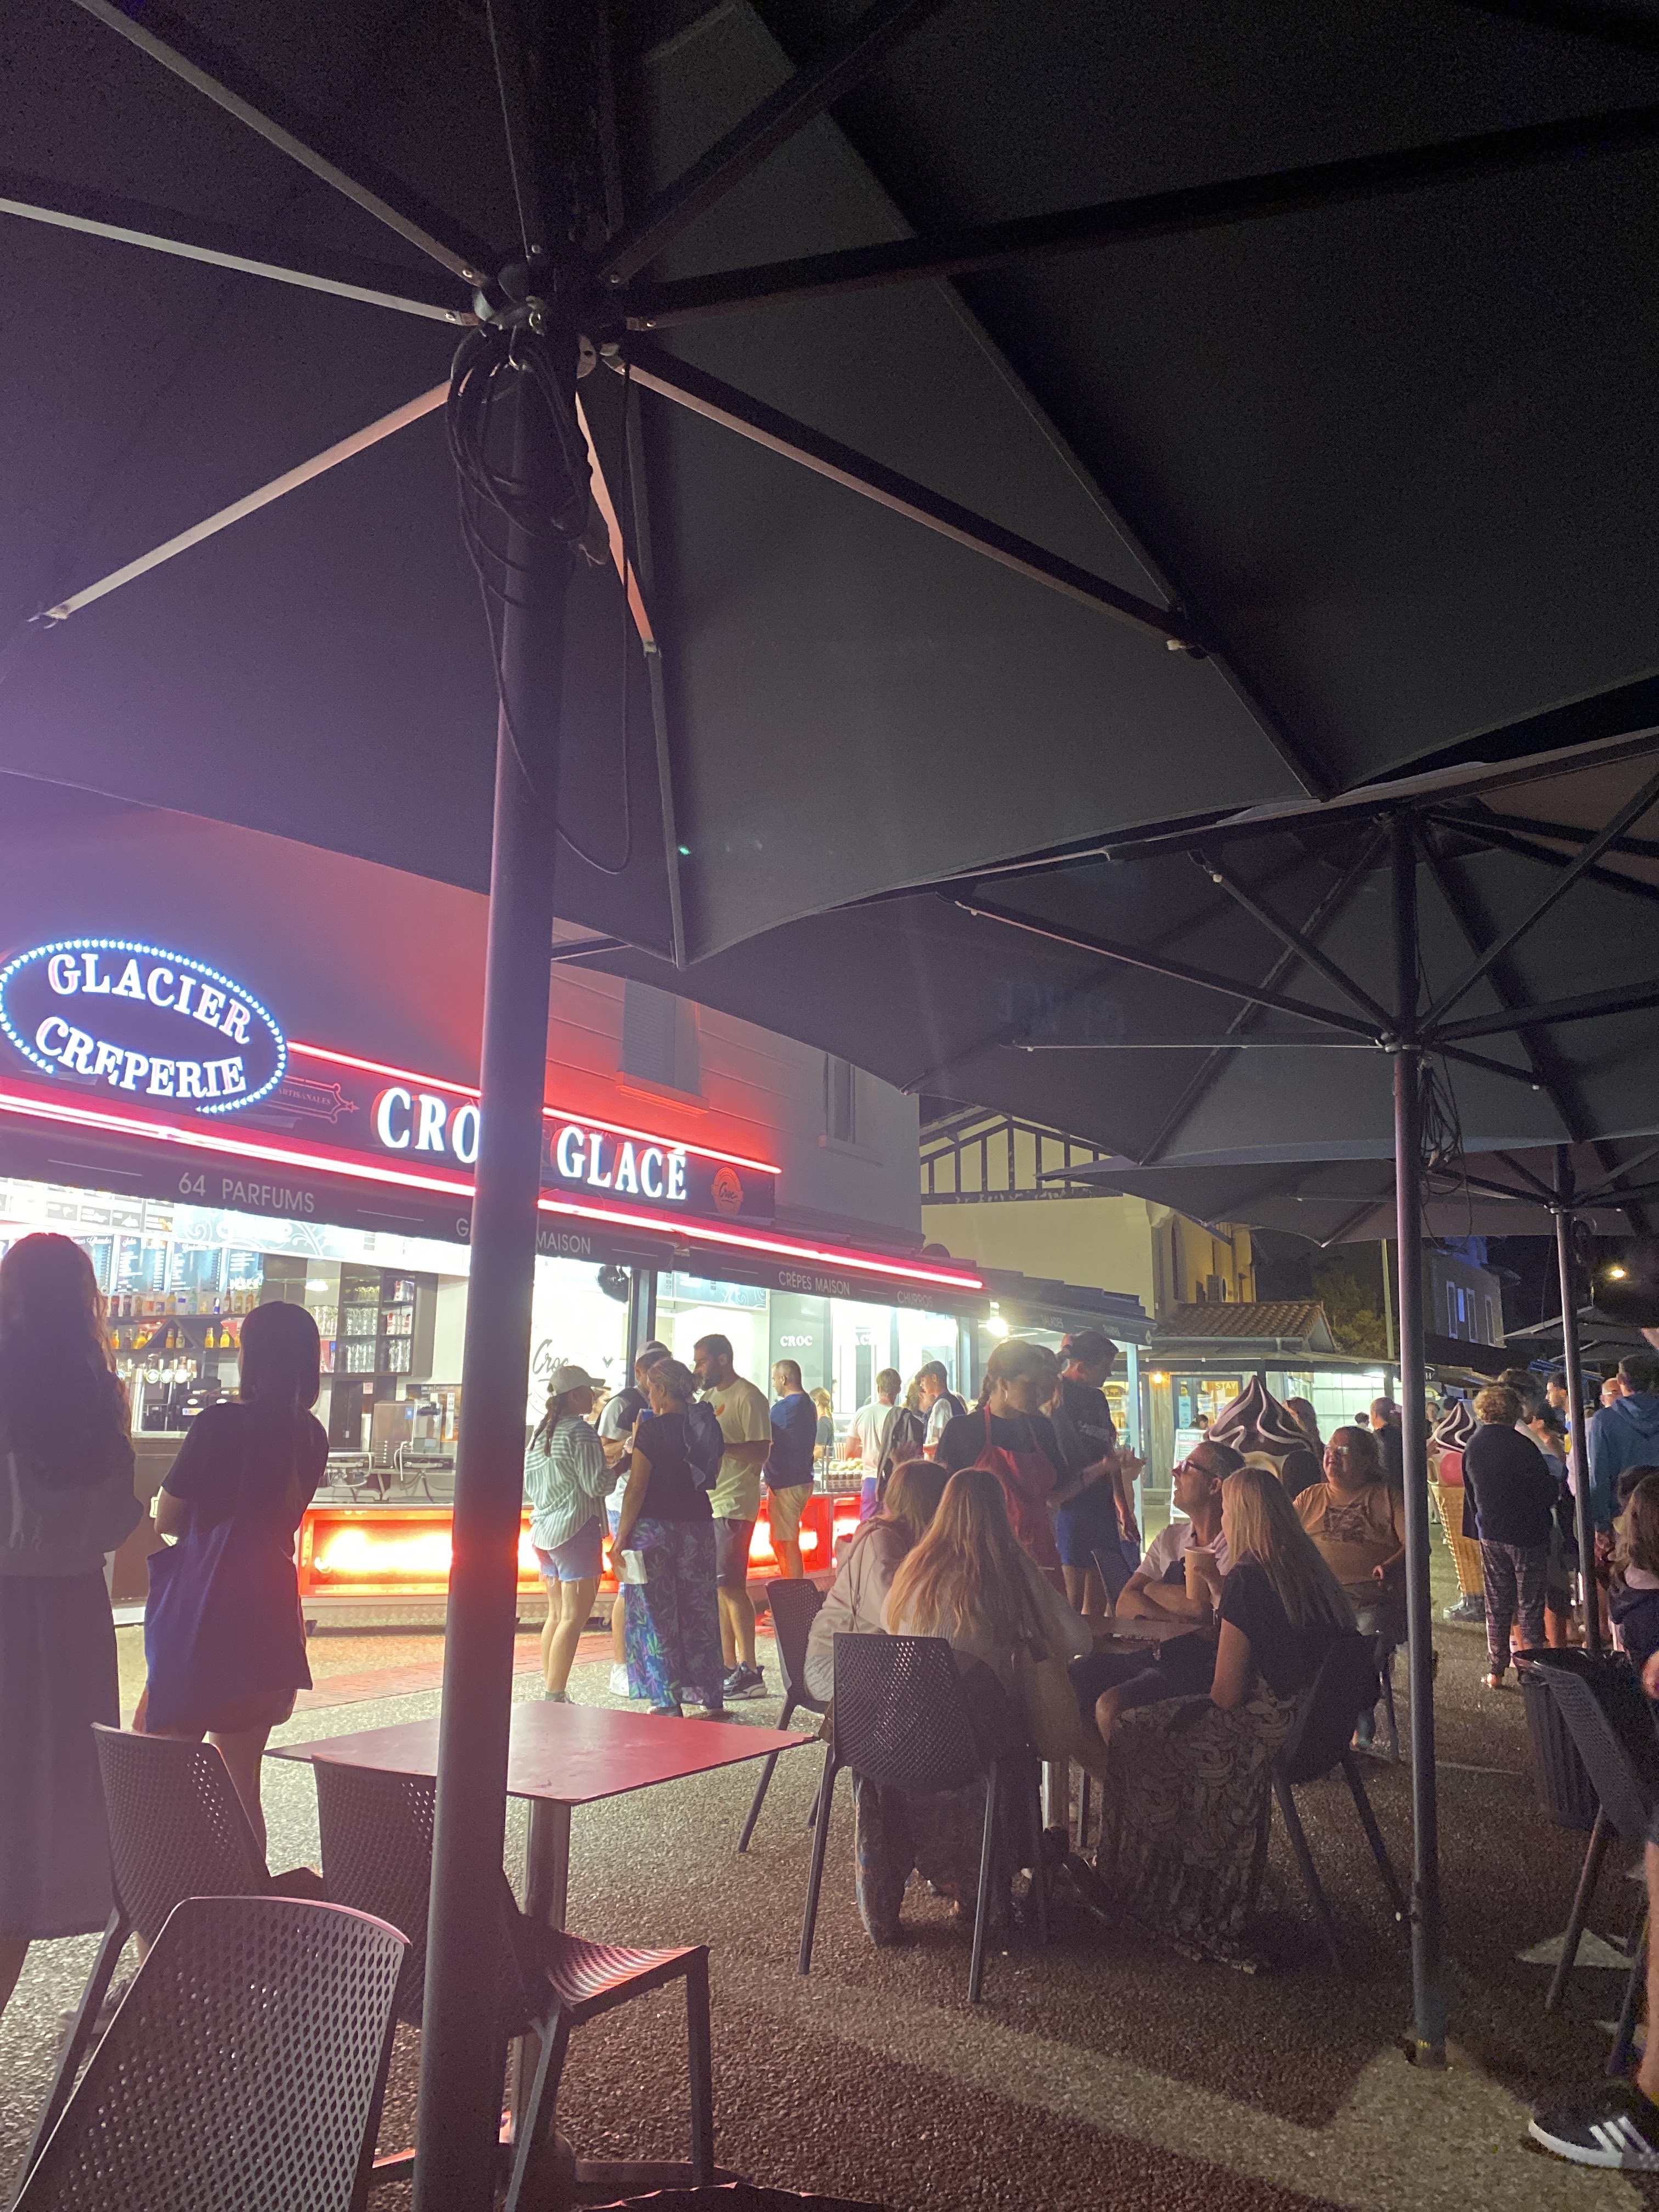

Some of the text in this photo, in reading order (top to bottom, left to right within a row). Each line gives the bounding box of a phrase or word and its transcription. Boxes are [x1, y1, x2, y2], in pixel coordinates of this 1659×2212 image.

[48, 953, 251, 1044] GLACIER
[35, 1016, 246, 1098] CREPERIE
[375, 1087, 687, 1200] CRO GLACÉ
[178, 1172, 314, 1214] 64 PARFUMS
[778, 1271, 850, 1295] CRÊPES MAISON
[897, 1290, 933, 1308] CHURROS
[780, 1335, 813, 1346] CROC
[1215, 1382, 1237, 1390] STAY
